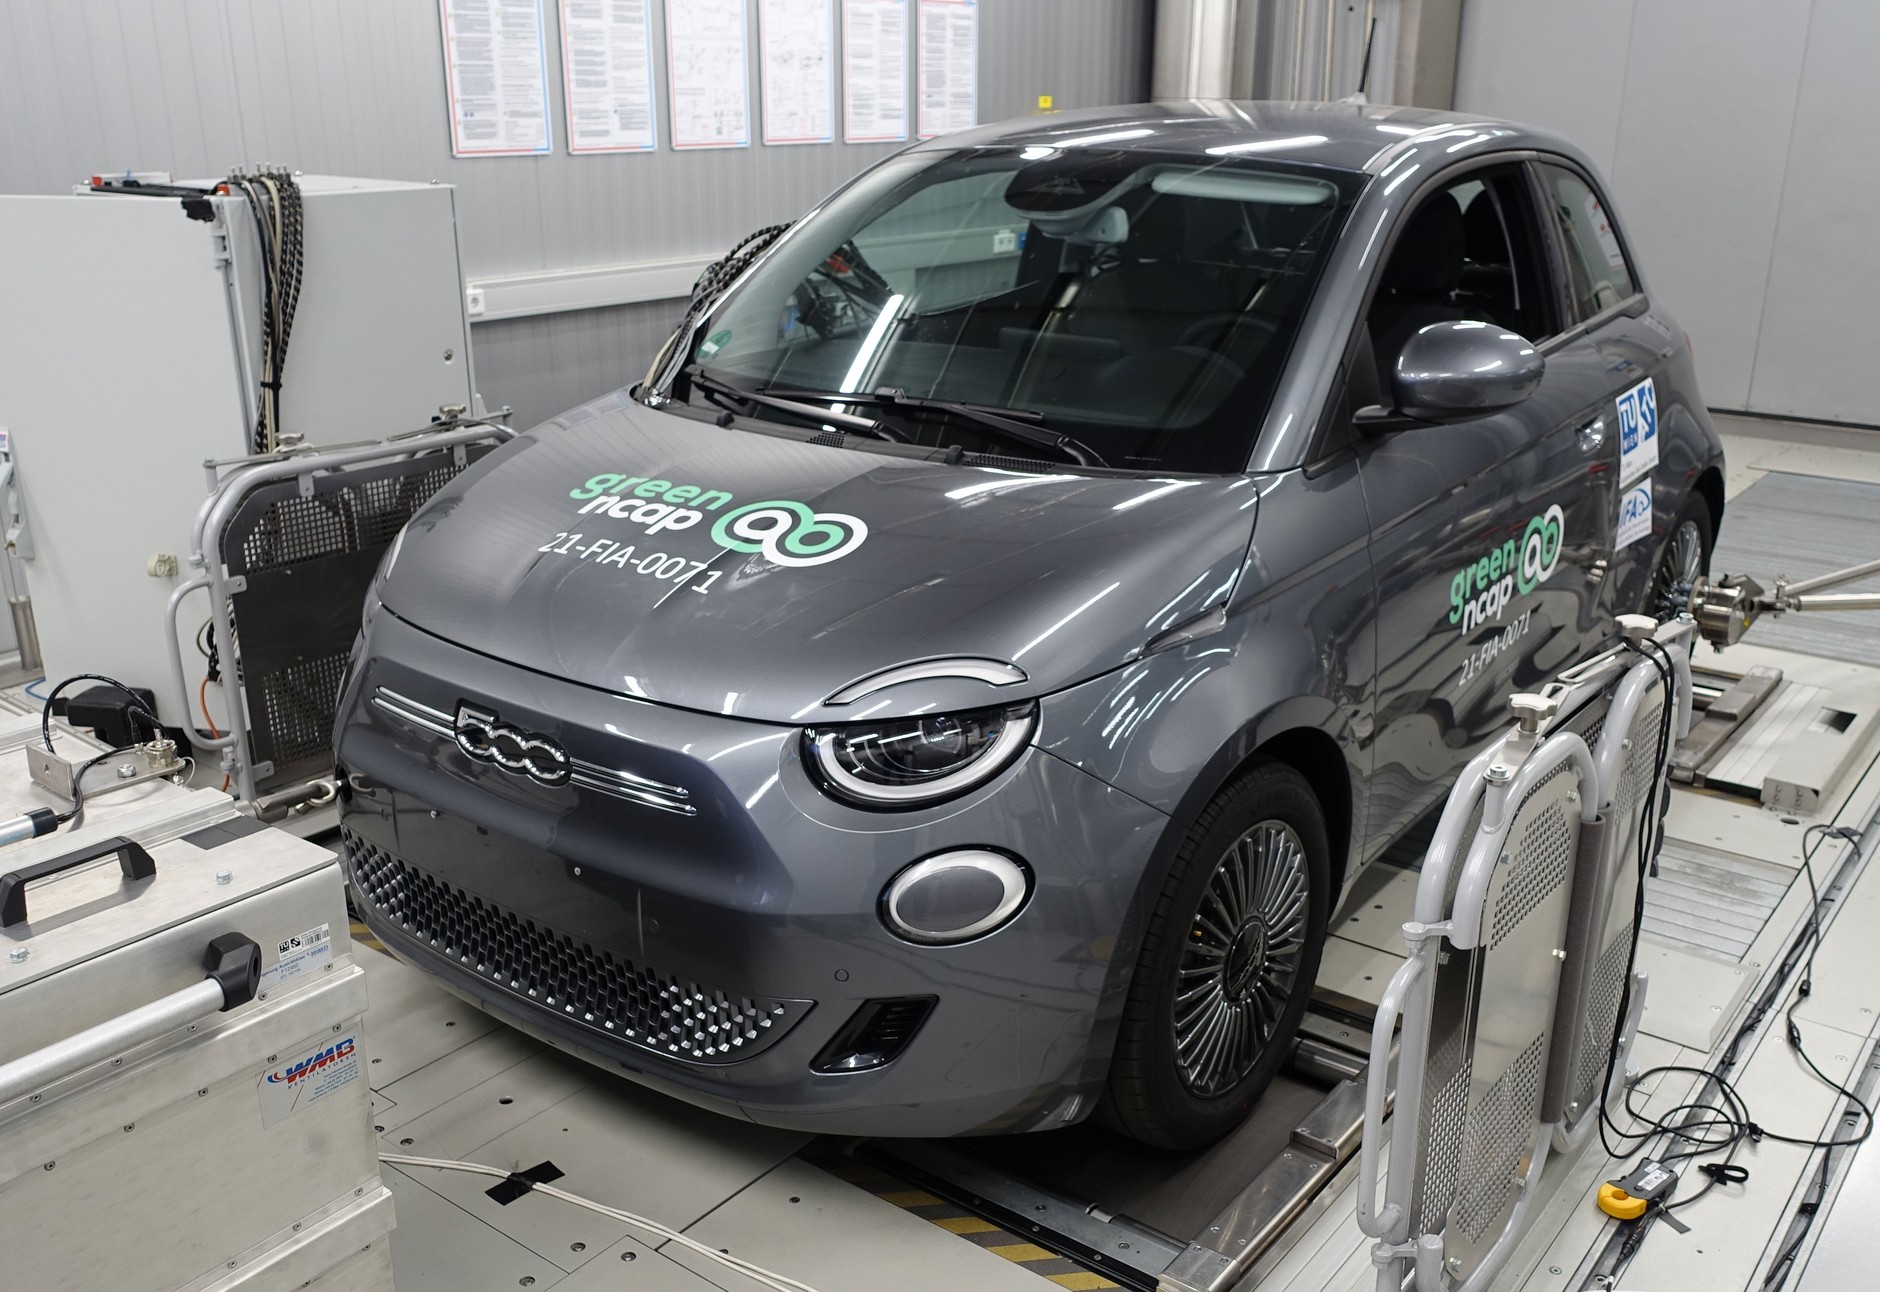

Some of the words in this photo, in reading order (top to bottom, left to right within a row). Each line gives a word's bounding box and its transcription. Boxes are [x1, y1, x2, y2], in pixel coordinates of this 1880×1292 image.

[569, 472, 734, 511] green
[577, 495, 703, 535] ncap
[538, 532, 723, 595] 21-FIA-0071
[1450, 538, 1516, 624] green
[1462, 574, 1513, 636] ncap
[1458, 609, 1531, 687] 21-FIA-0071
[456, 703, 569, 785] 500
[285, 1038, 355, 1084] WMB
[287, 1052, 356, 1090] VENTILATOREN
